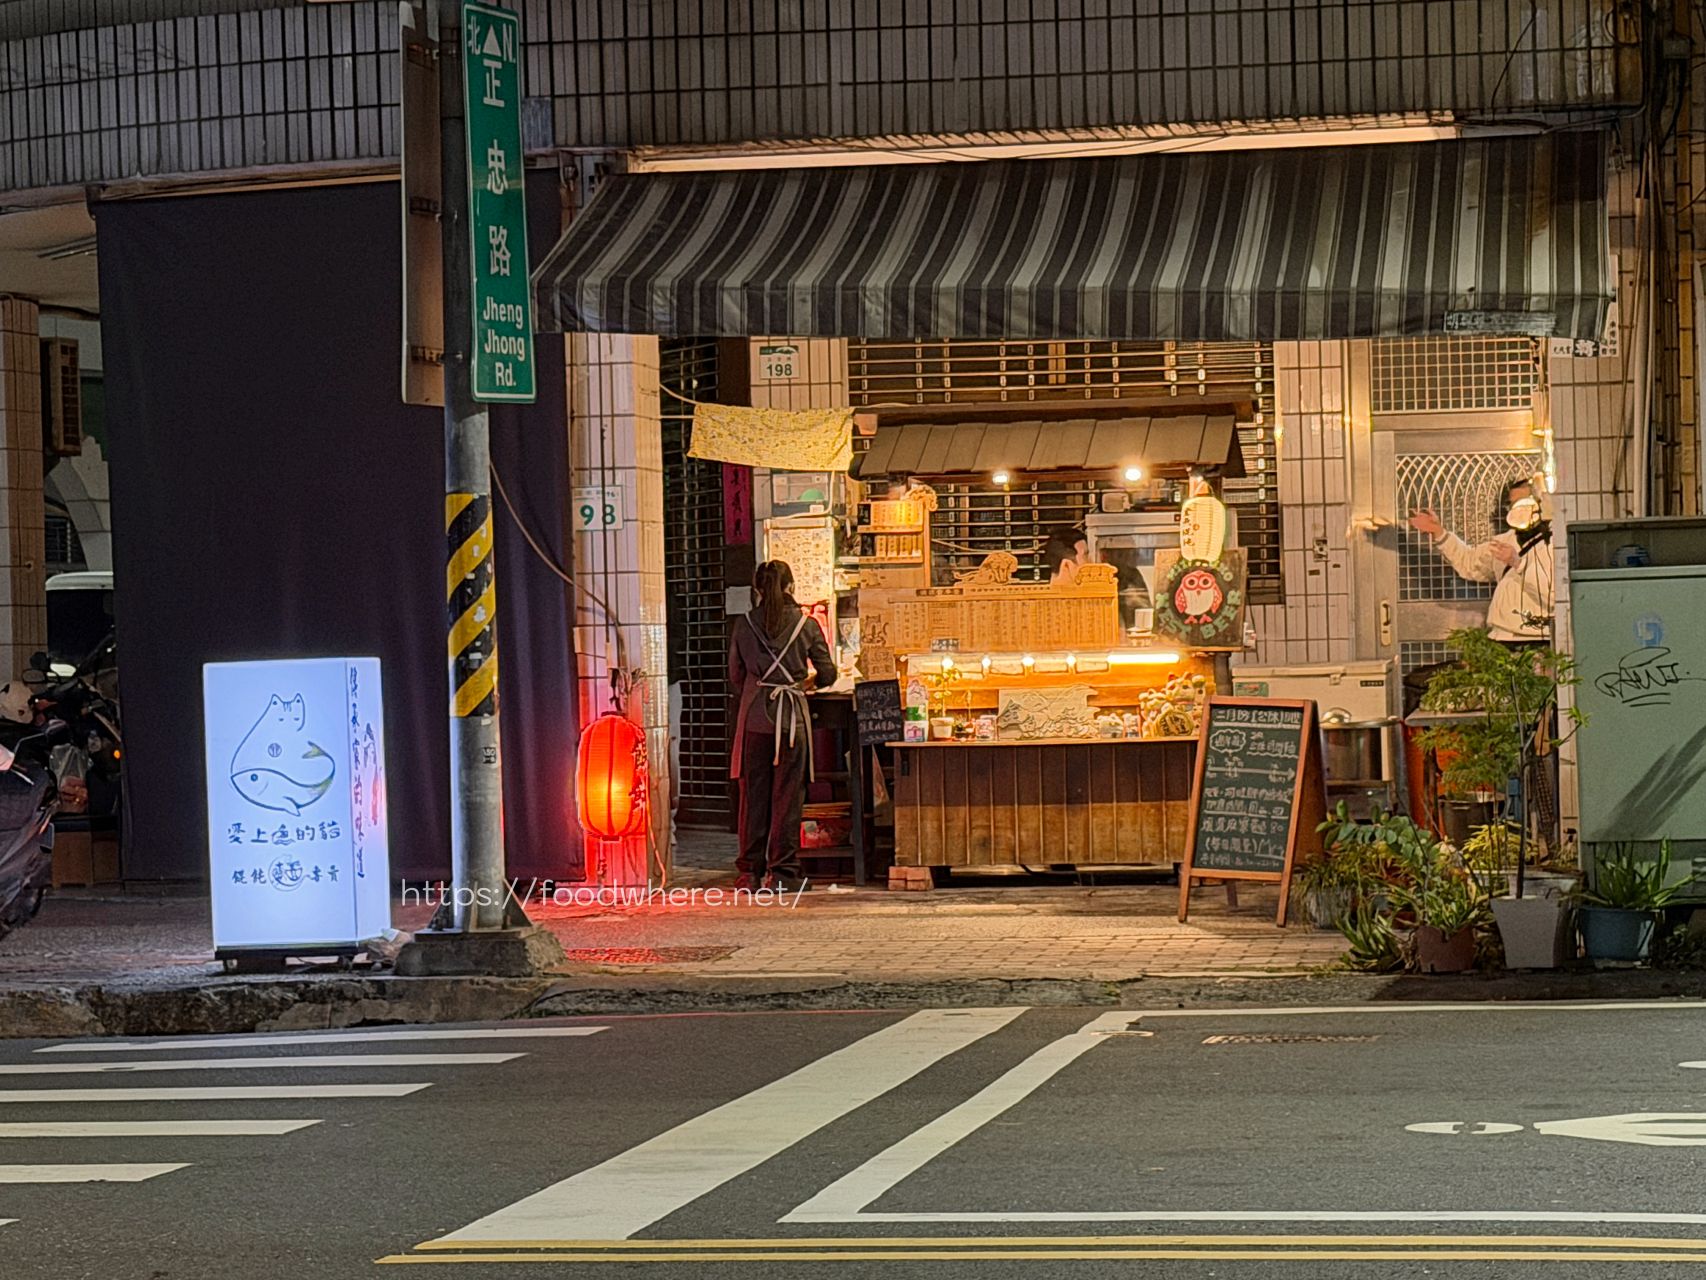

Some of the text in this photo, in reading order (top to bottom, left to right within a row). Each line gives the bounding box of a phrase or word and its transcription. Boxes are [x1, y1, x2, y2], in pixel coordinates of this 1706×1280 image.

[467, 14, 482, 56] 北
[481, 57, 512, 278] 正忠路
[483, 296, 524, 331] Jheng
[484, 329, 526, 362] Jhong
[495, 361, 517, 387] Rd.
[766, 363, 793, 377] 198
[580, 504, 616, 526] 98
